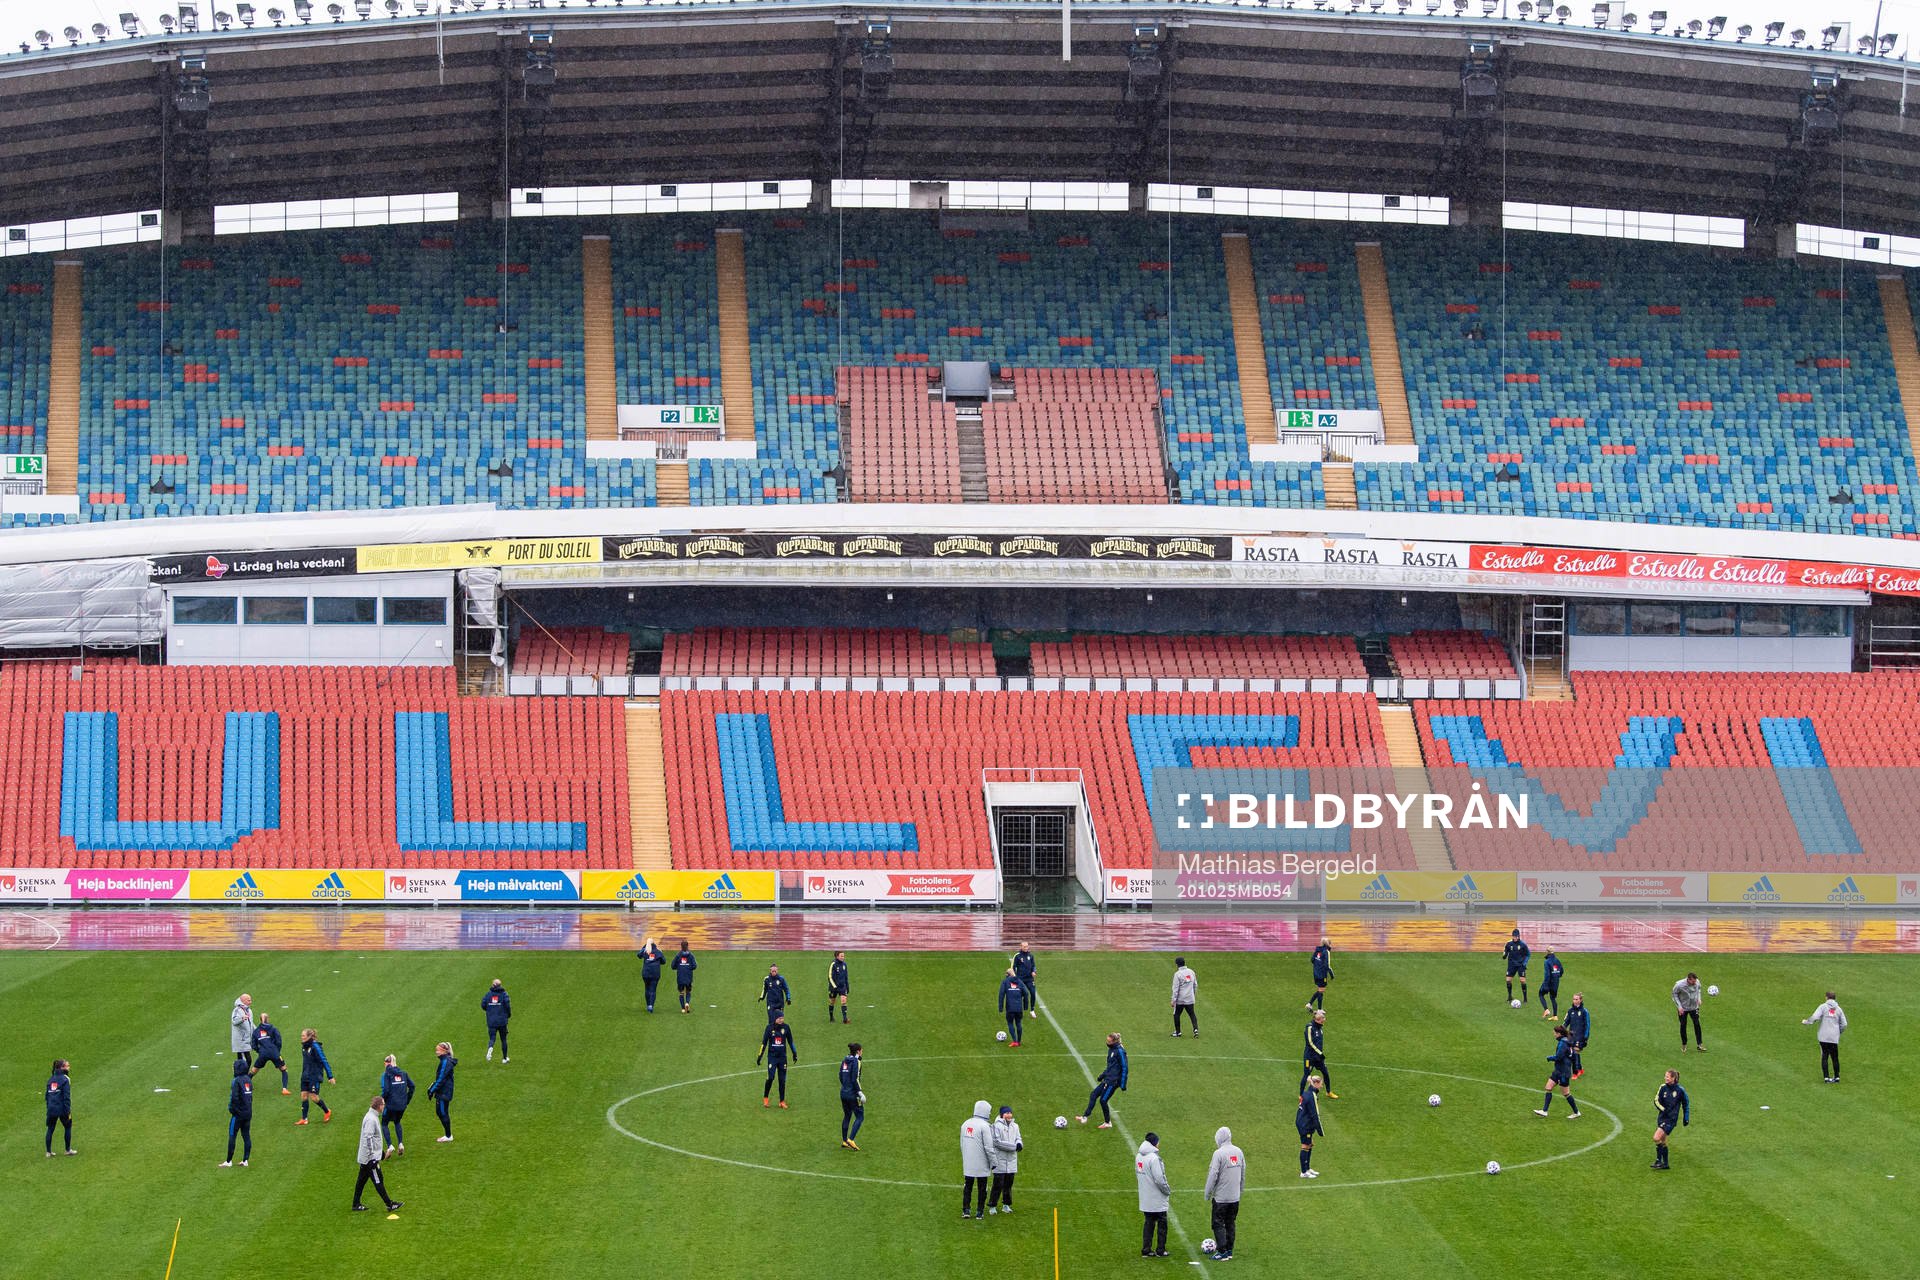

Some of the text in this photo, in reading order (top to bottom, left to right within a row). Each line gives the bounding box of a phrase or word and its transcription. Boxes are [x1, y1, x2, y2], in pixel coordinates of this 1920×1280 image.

[663, 411, 678, 422] P2
[1319, 416, 1336, 426] A2
[508, 542, 592, 560] PORT DU SOLEIL
[619, 540, 678, 559] KOPPARBERG
[686, 540, 744, 558] KOPPARBERG
[776, 539, 836, 557] KOPPARBERG
[843, 539, 902, 556] KOPPARBERG
[933, 538, 992, 557] KOPPARBERG
[1000, 538, 1058, 557] KOPPARBERG
[1090, 540, 1149, 557] KOPPARBERG
[1156, 540, 1215, 558] KOPPARBERG
[1244, 547, 1300, 562] RASTA
[1324, 548, 1380, 564] RASTA
[1402, 551, 1458, 568] RASTA
[1481, 550, 1545, 569] Estrella
[1553, 554, 1617, 573] Estrella
[233, 557, 345, 573] Lördag hela veckan!
[1628, 555, 1705, 579] Estrella
[1709, 560, 1786, 584] Estrella
[1800, 567, 1864, 585] Estrella
[77, 878, 174, 892] Heja backlinjen!
[468, 878, 563, 893] Heja målvakten!
[909, 876, 952, 885] Fotbollens
[1621, 878, 1664, 887] Fotbollens
[224, 888, 264, 898] adidas
[311, 888, 351, 898] adidas
[616, 889, 656, 899] adidas
[703, 889, 742, 899] adidas
[901, 885, 960, 895] huvudsponsor
[1360, 890, 1399, 900] adidas
[1445, 890, 1484, 900] adidas
[1613, 887, 1672, 897] huvudsponsor
[1742, 890, 1781, 901] adidas
[1827, 891, 1866, 902] adidas
